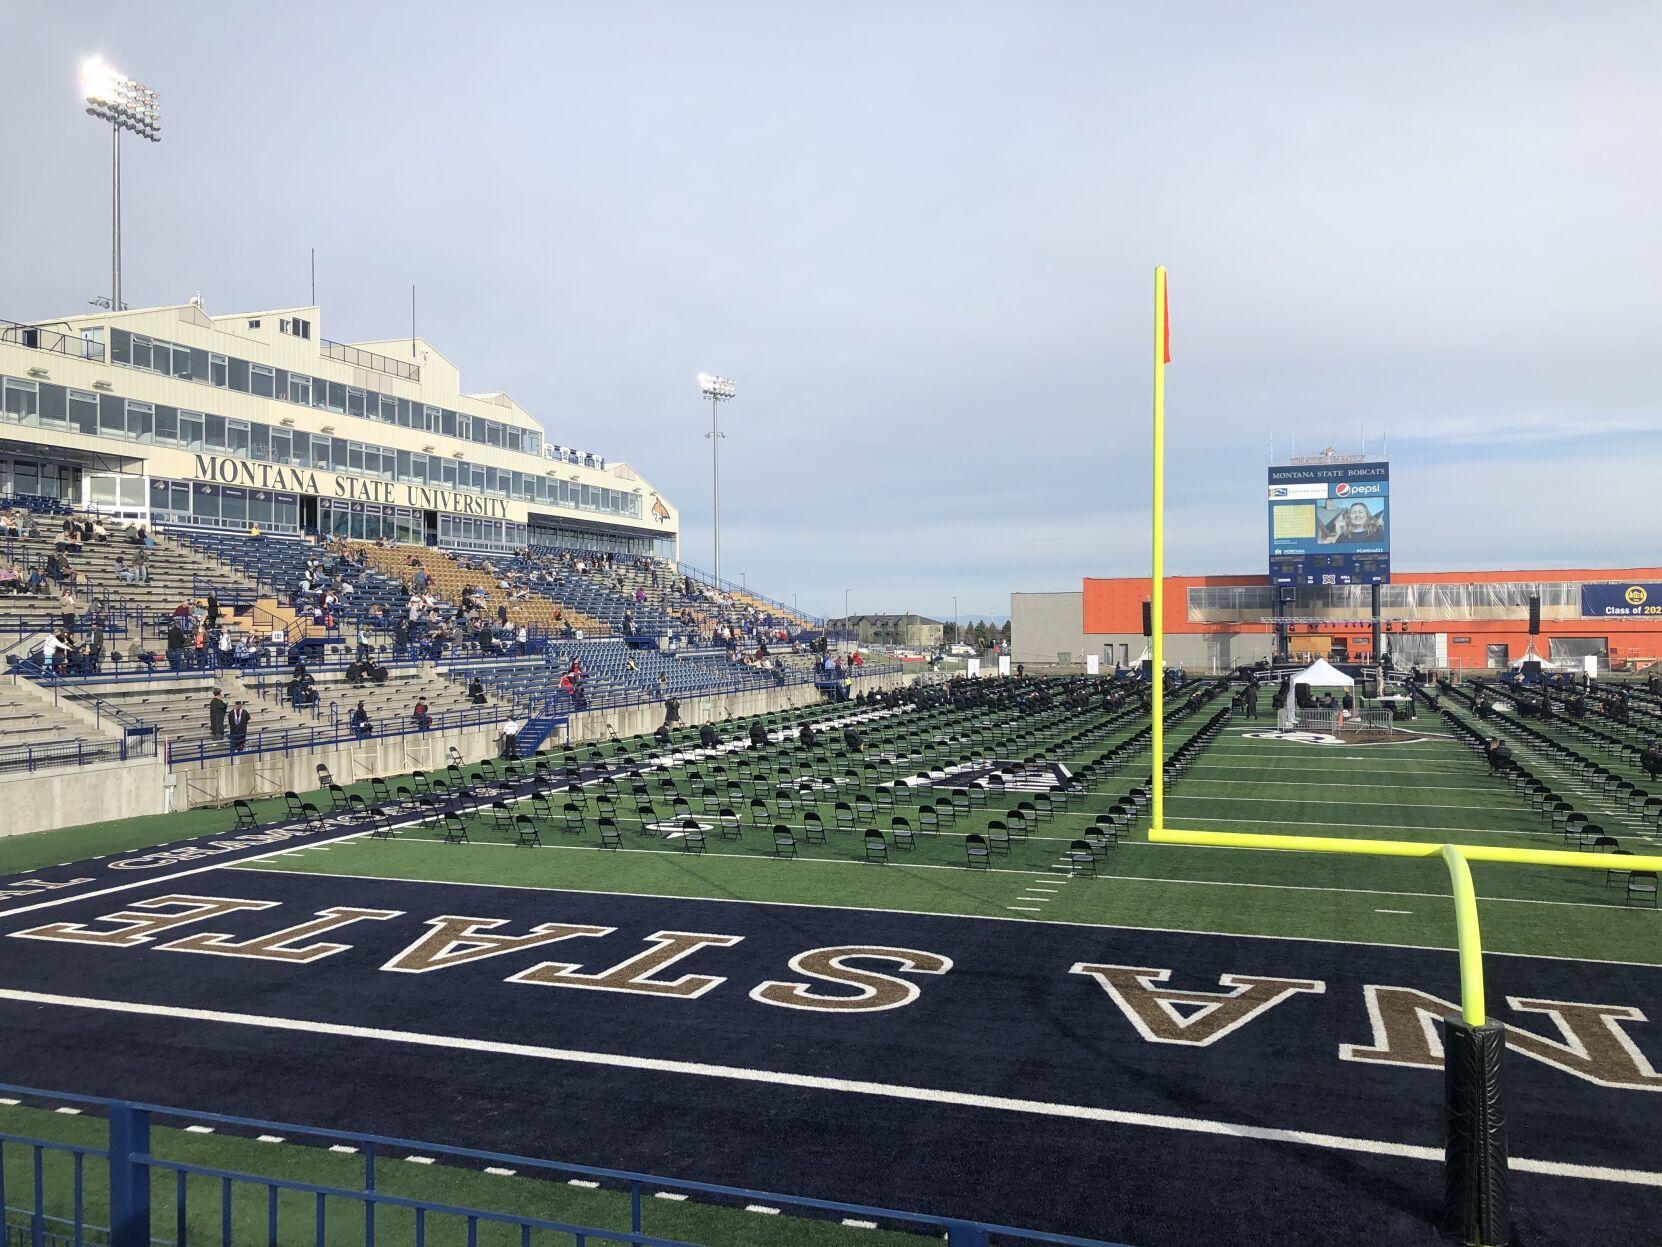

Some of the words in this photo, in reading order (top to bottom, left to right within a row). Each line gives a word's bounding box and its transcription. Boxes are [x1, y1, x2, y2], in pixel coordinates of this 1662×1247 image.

[1272, 471, 1314, 480] MONTANA
[1317, 470, 1344, 478] STATE
[1347, 468, 1385, 476] BOBCATS
[194, 453, 320, 495] MONTANA
[334, 475, 396, 505] STATE
[406, 484, 511, 519] UNIVERSITY
[1350, 483, 1381, 495] pepsi
[1605, 606, 1630, 614] Class
[1632, 606, 1642, 614] of
[6, 894, 955, 1014] STATE
